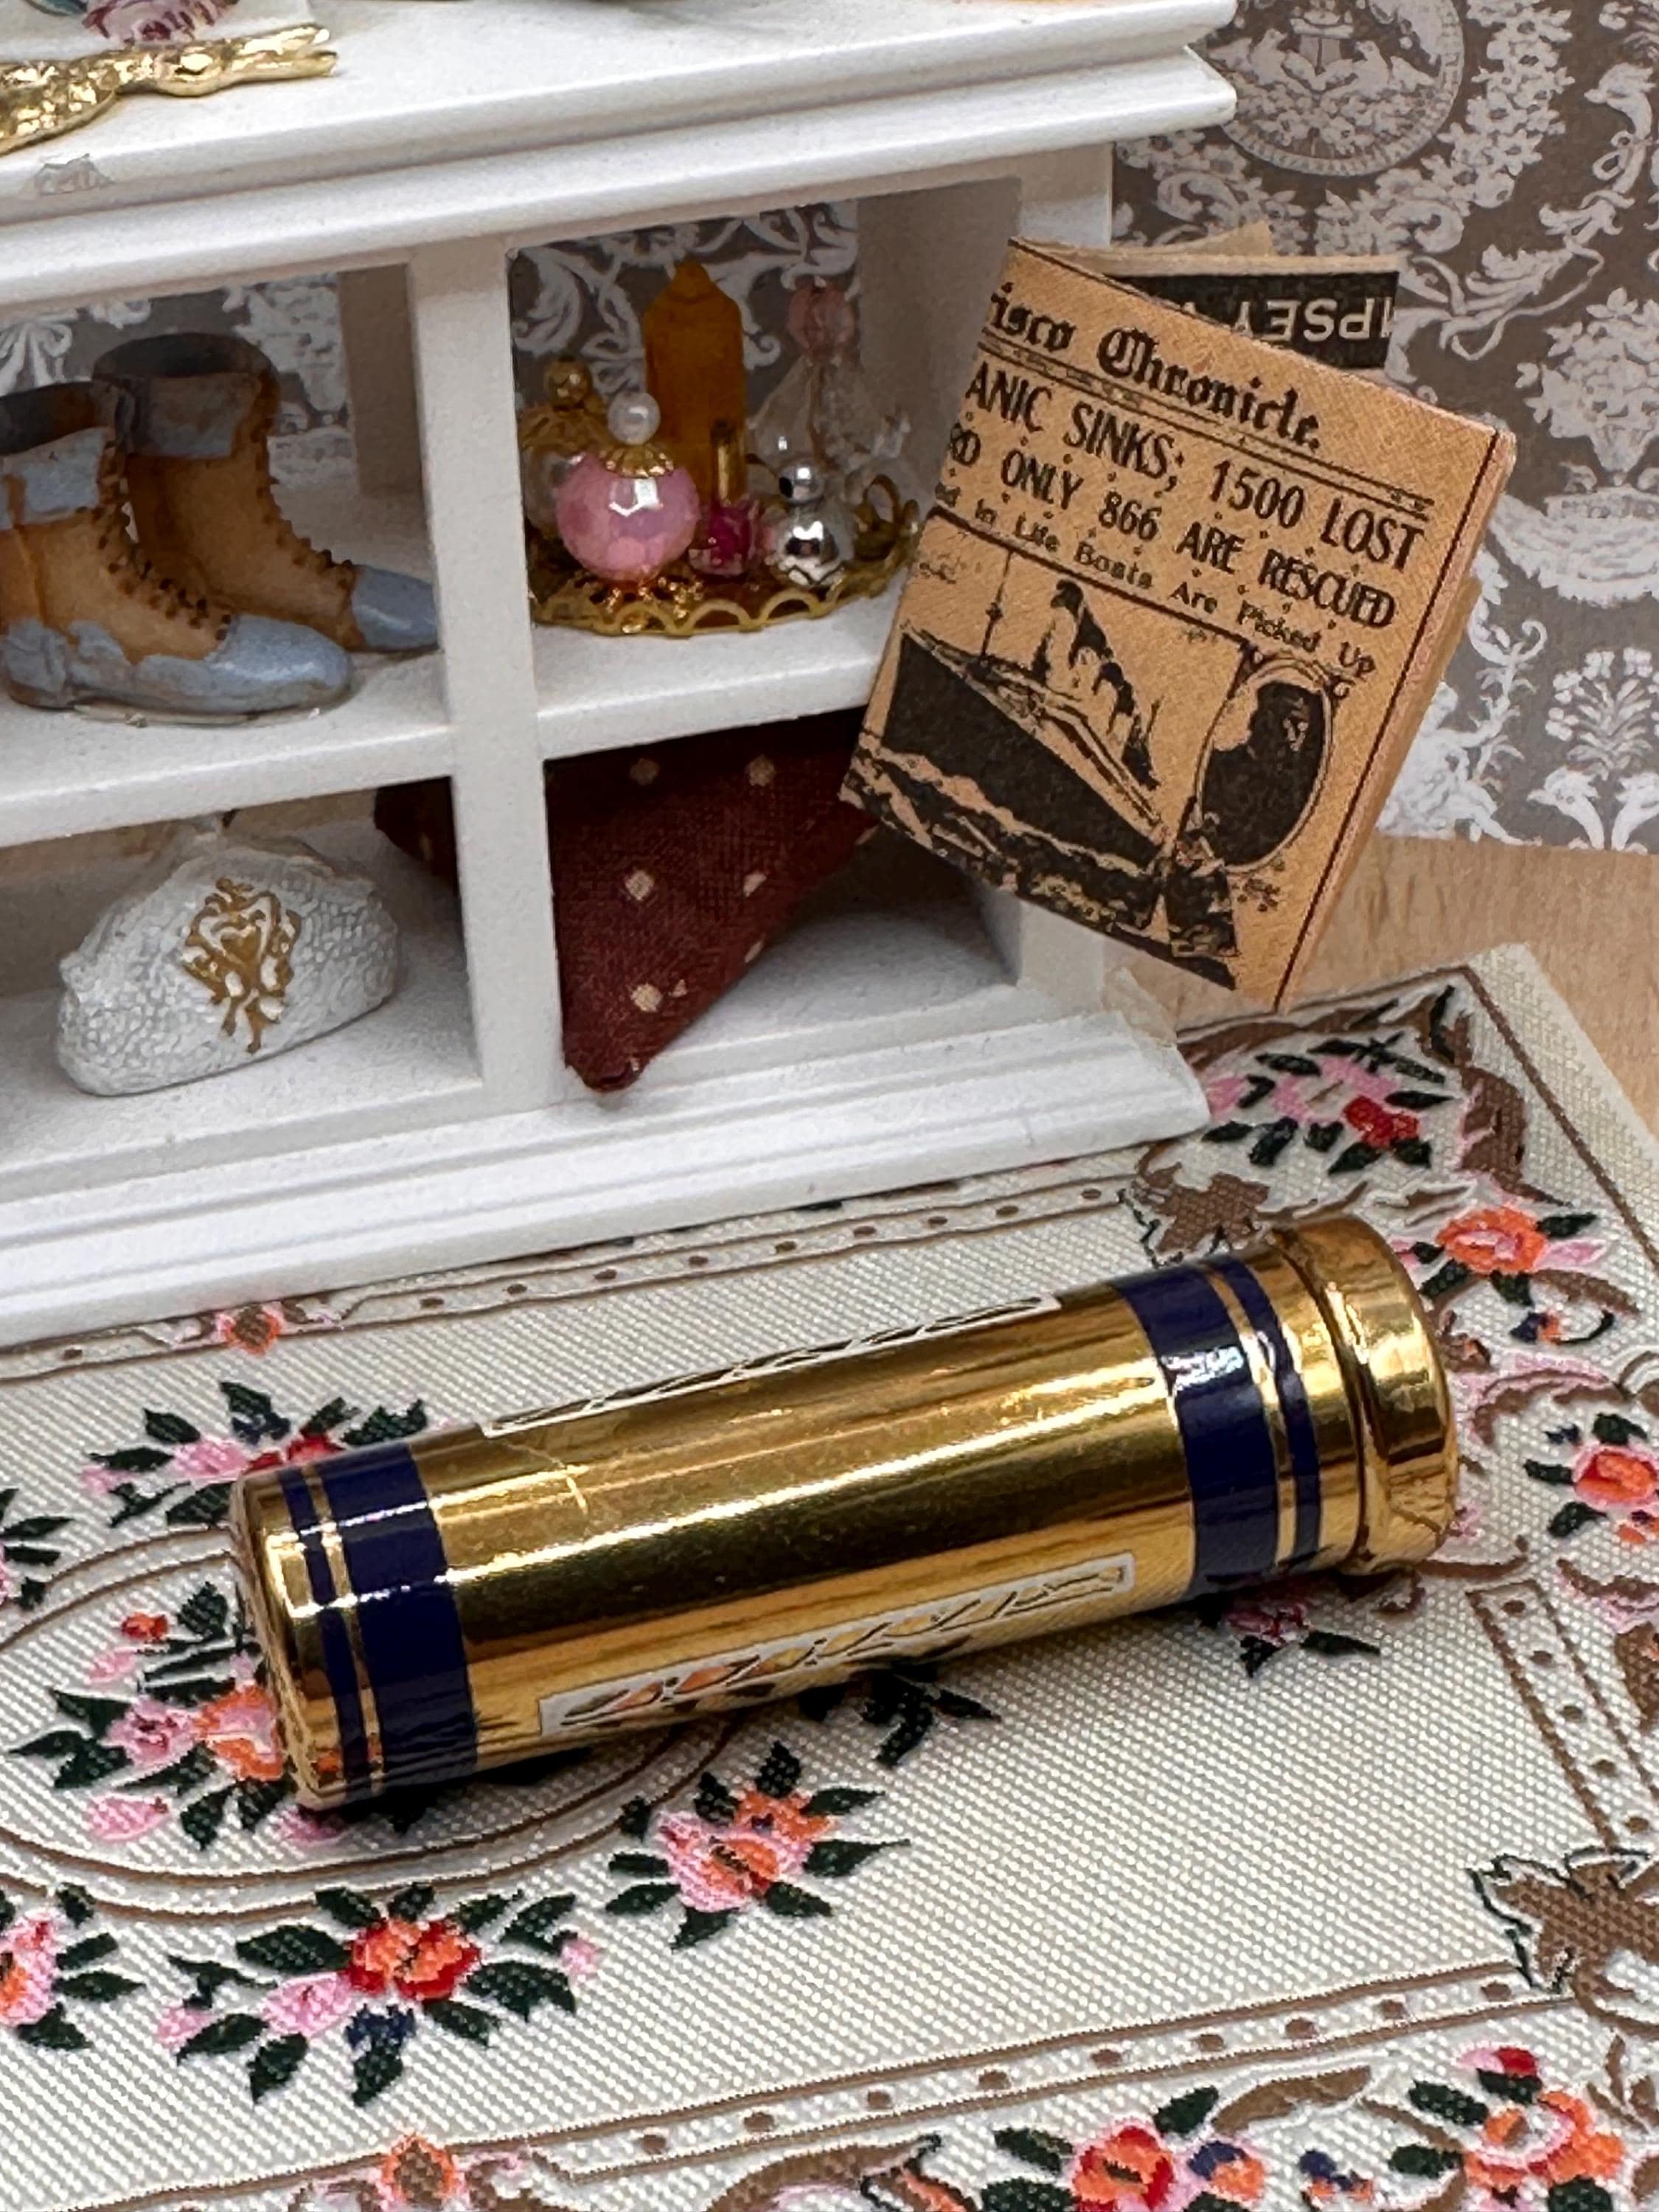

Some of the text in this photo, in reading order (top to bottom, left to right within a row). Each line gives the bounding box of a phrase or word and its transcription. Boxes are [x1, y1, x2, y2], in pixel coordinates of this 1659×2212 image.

[1001, 449, 1085, 510] ONLY
[1098, 488, 1162, 541] 866
[1173, 521, 1246, 575] ARE
[1257, 549, 1396, 628] RESCUED
[1062, 400, 1185, 493] SINKS;
[1210, 459, 1305, 529] 1500
[1321, 498, 1425, 572] LOST
[1075, 540, 1153, 591] Boats
[1169, 581, 1219, 614] Are
[1338, 641, 1377, 678] Up
